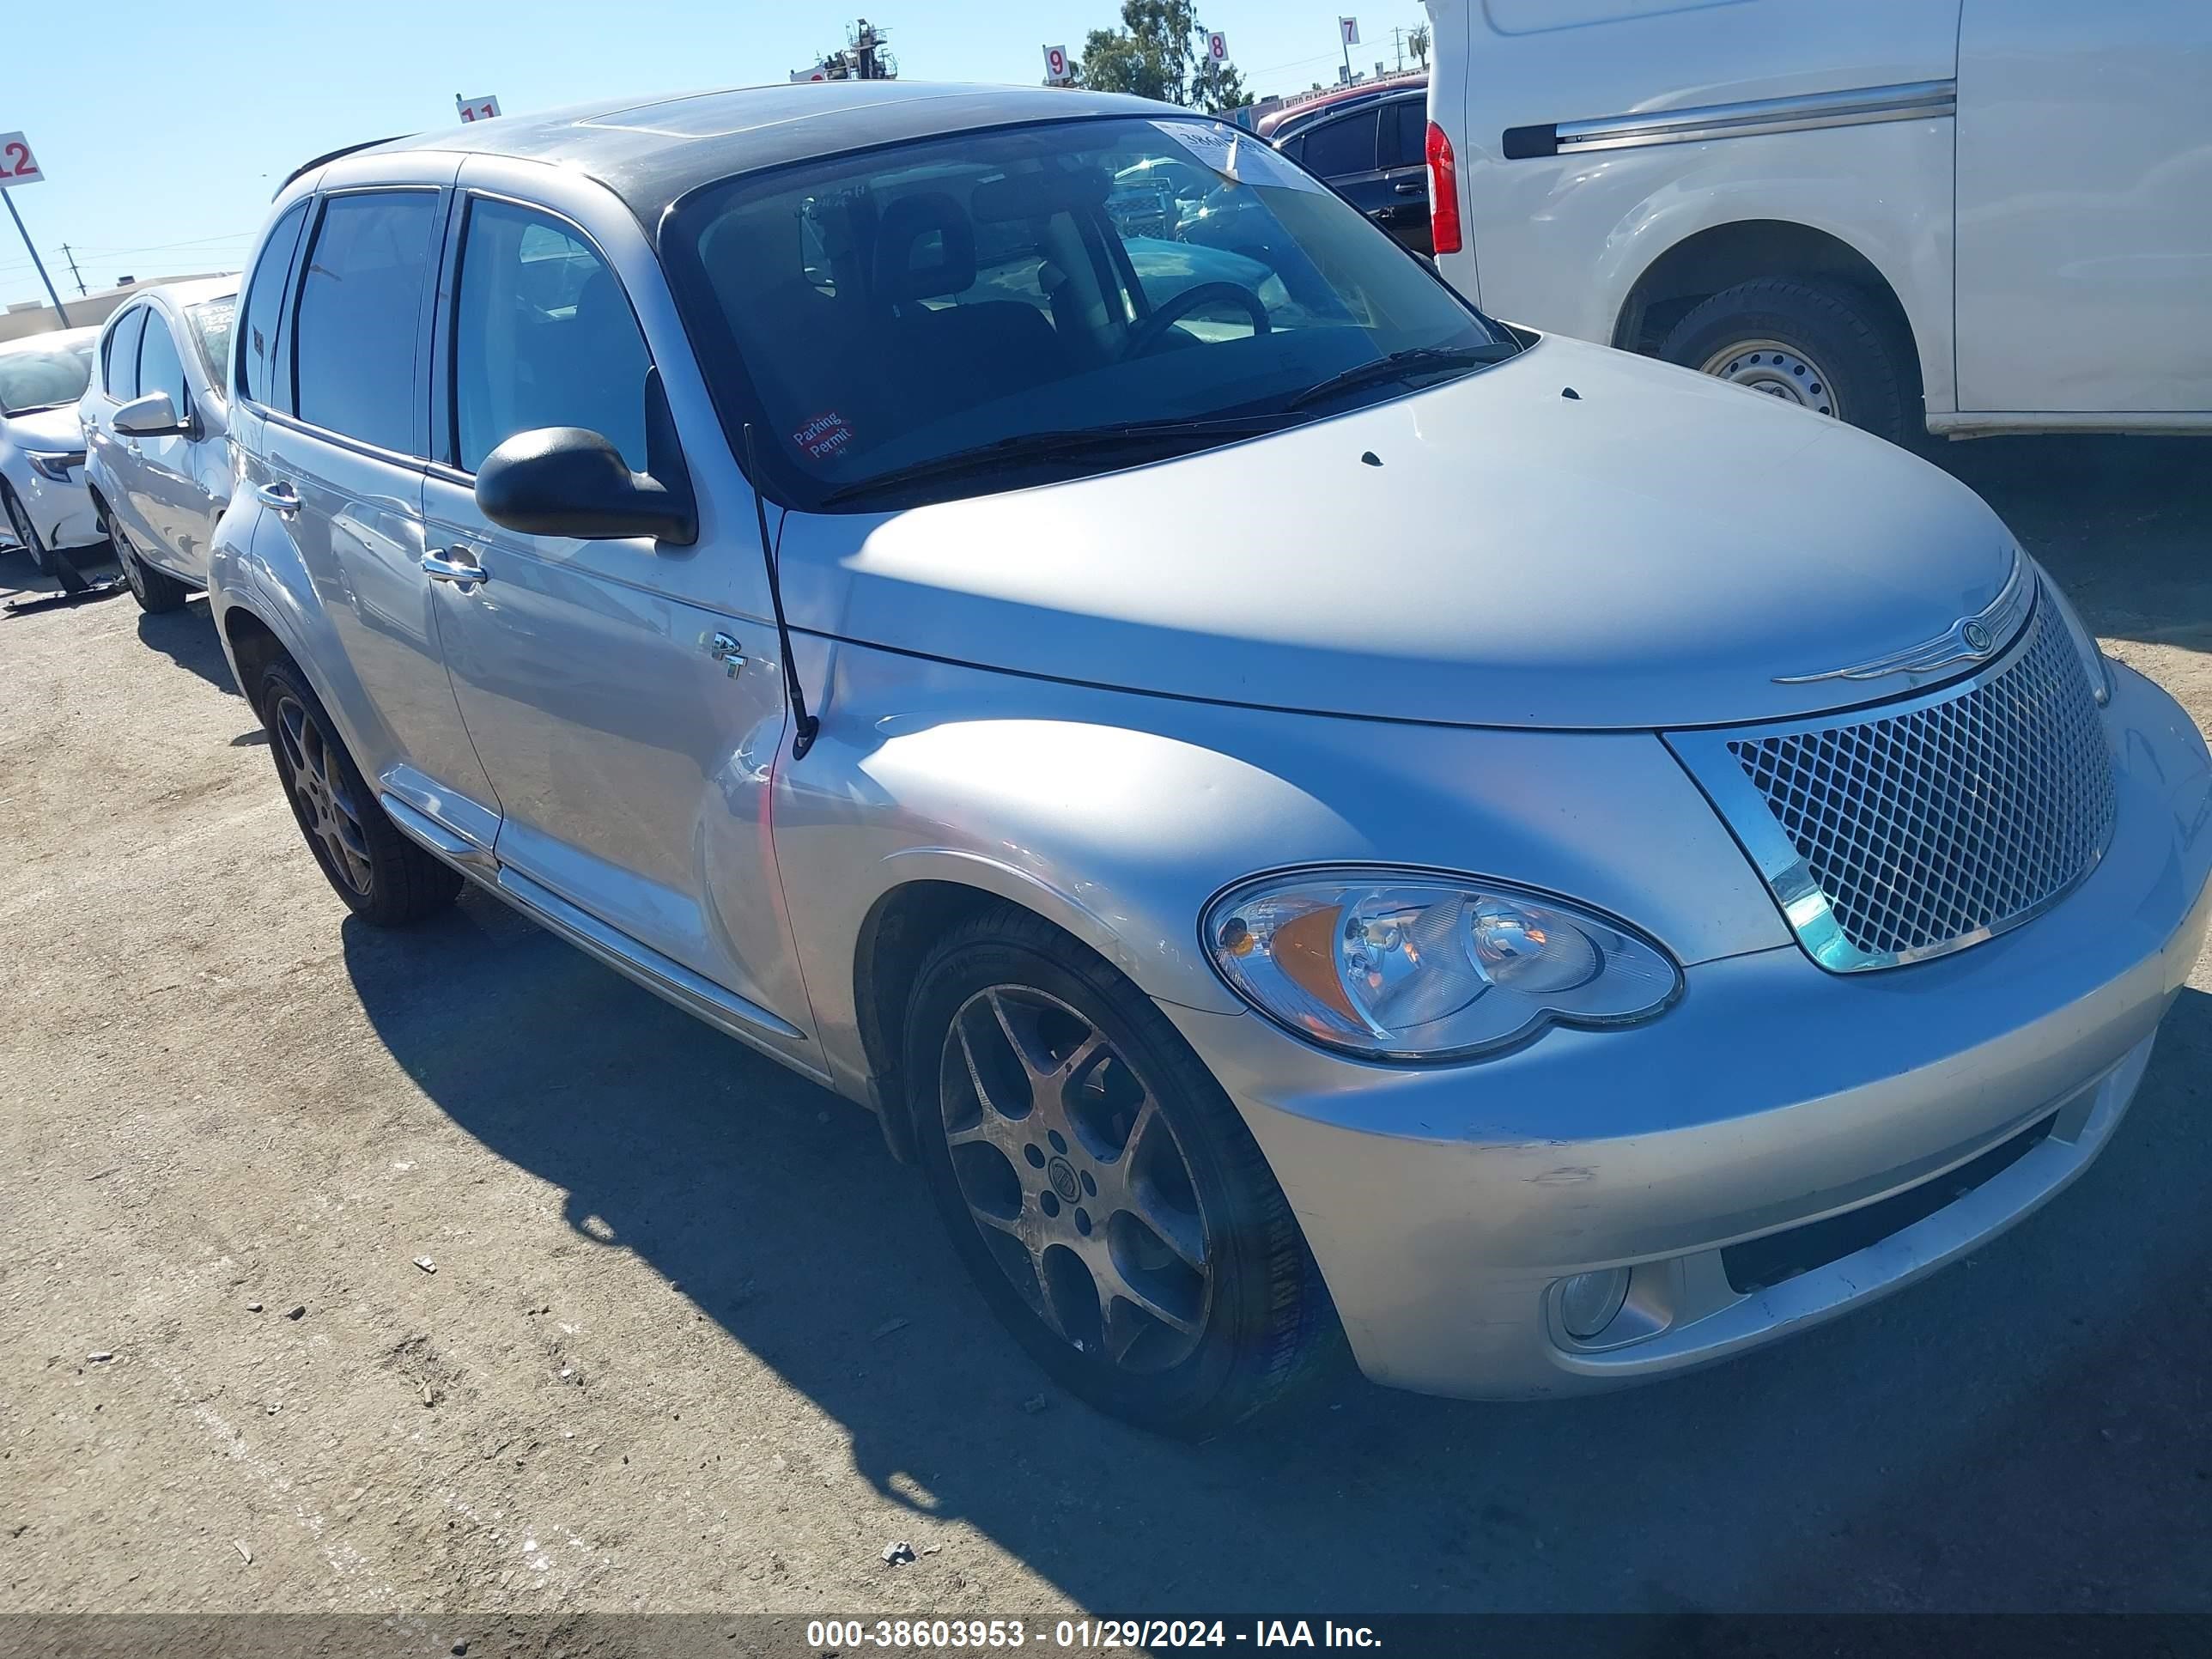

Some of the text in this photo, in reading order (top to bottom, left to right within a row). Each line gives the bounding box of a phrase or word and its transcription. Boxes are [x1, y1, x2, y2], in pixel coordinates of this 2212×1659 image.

[1344, 21, 1353, 42] 7
[1212, 35, 1224, 58] 8
[1049, 50, 1064, 76] 9
[793, 411, 842, 446] Parking
[810, 428, 852, 459] Permit
